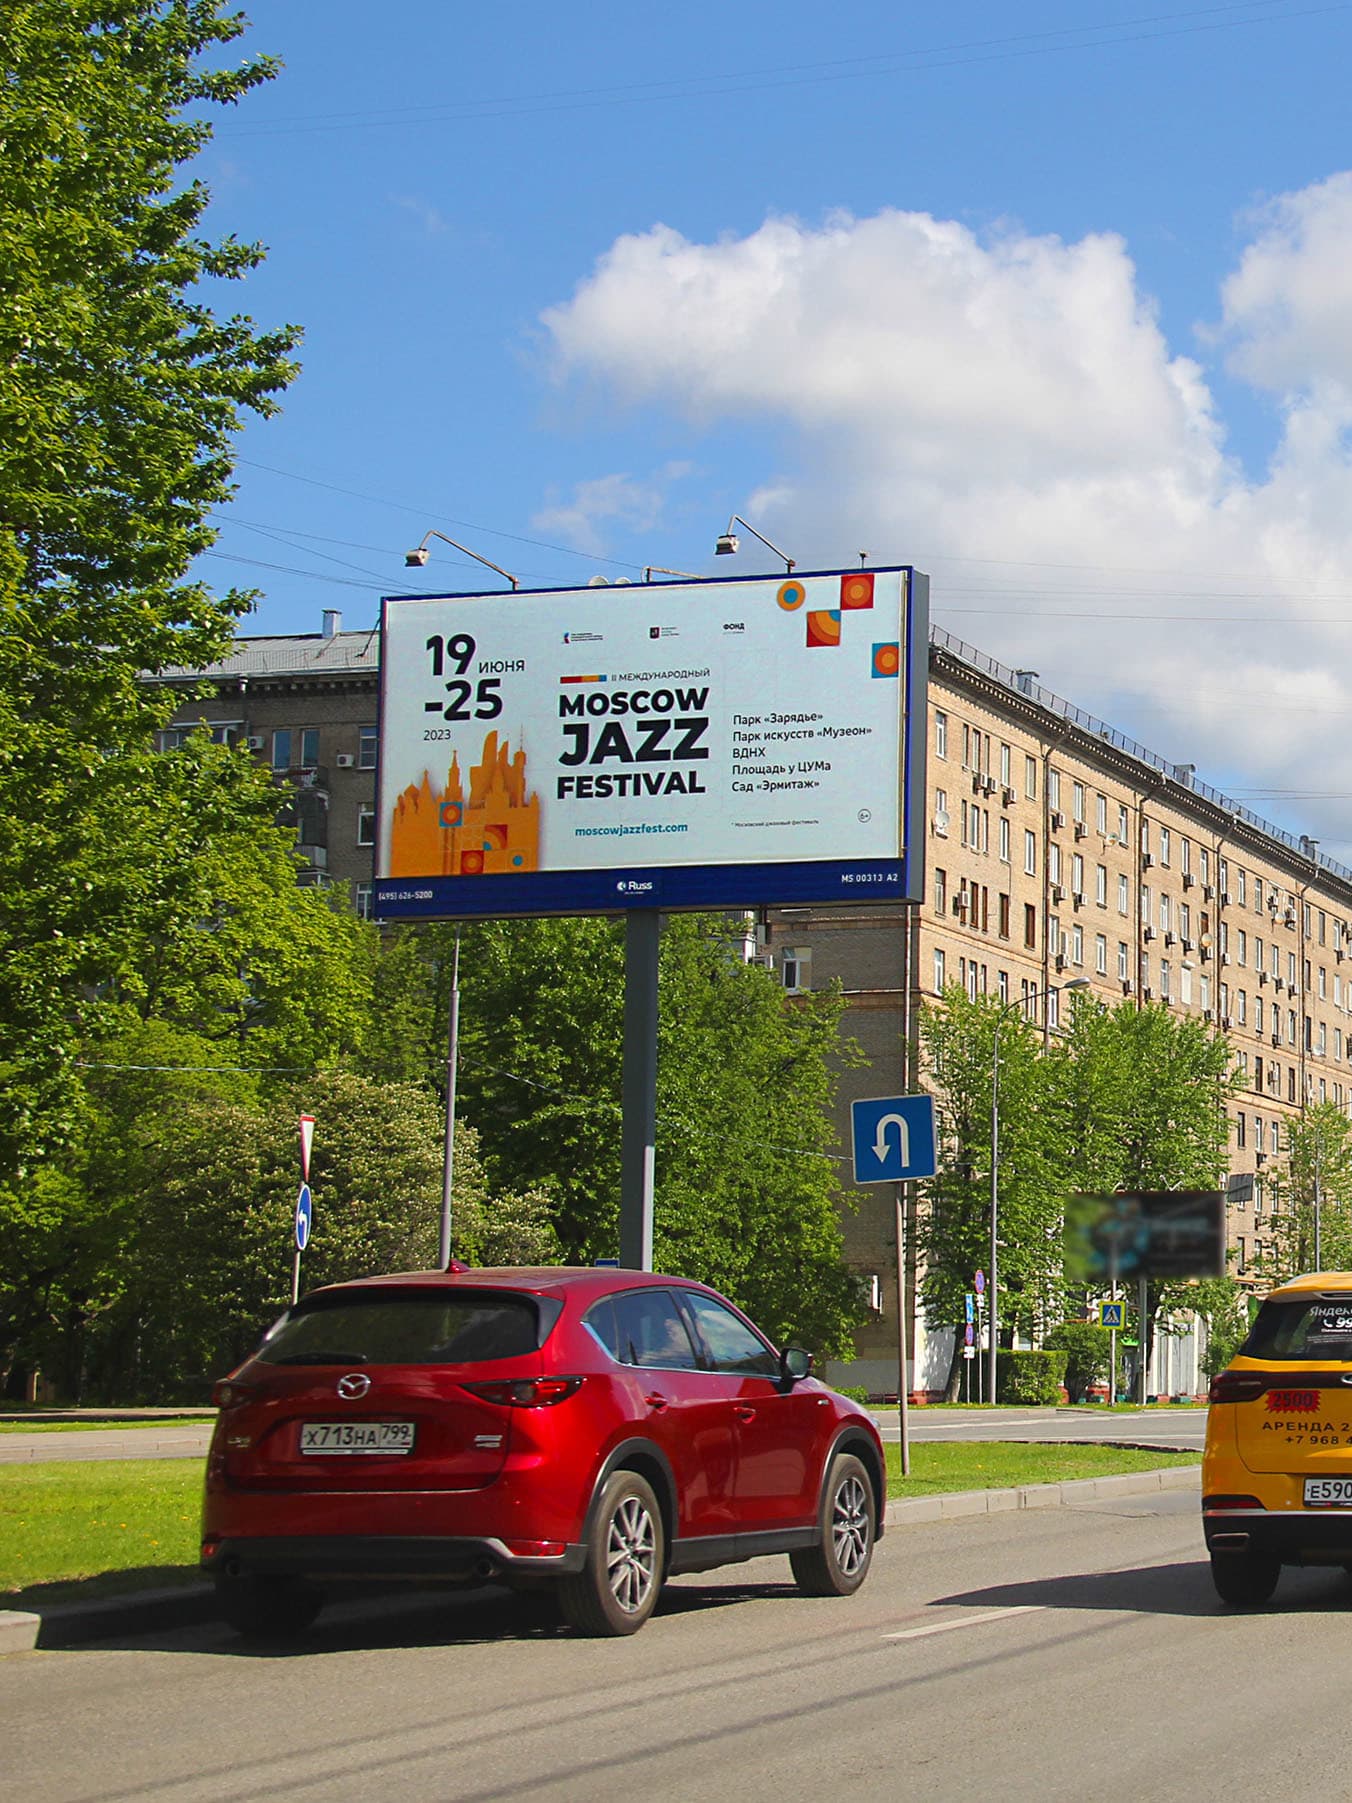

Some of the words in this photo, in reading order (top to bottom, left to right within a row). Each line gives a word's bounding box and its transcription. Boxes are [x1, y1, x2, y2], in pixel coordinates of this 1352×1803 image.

[723, 623, 745, 631] ФОНД
[426, 633, 476, 676] 19
[618, 668, 710, 682] МЕЖДУНАРОДНЫЙ
[424, 678, 503, 721] -25
[559, 687, 710, 717] MOSCOW
[733, 715, 761, 726] Парк
[764, 712, 823, 725] «Зарядье»
[423, 729, 451, 741] 2023
[558, 717, 710, 766] JAZZ
[733, 731, 760, 743] Парк
[764, 729, 814, 741] искусств
[817, 726, 872, 739] «Музеон»
[732, 747, 766, 759] ВДНХ
[732, 764, 786, 775] Площадь
[788, 765, 795, 774] у
[798, 761, 831, 773] ЦУМа
[557, 770, 706, 799] FESTIVAL
[732, 781, 753, 792] Сад
[756, 779, 820, 792] «Эрмитаж»
[575, 823, 688, 837] moscowjazzfest.com
[841, 874, 854, 883] MS
[856, 874, 883, 882] 00313
[886, 873, 899, 881] A2
[628, 881, 653, 890] Russ
[1262, 1421, 1335, 1432] АРЕНДА
[1286, 1436, 1303, 1444] +7
[1310, 1436, 1339, 1445] 968
